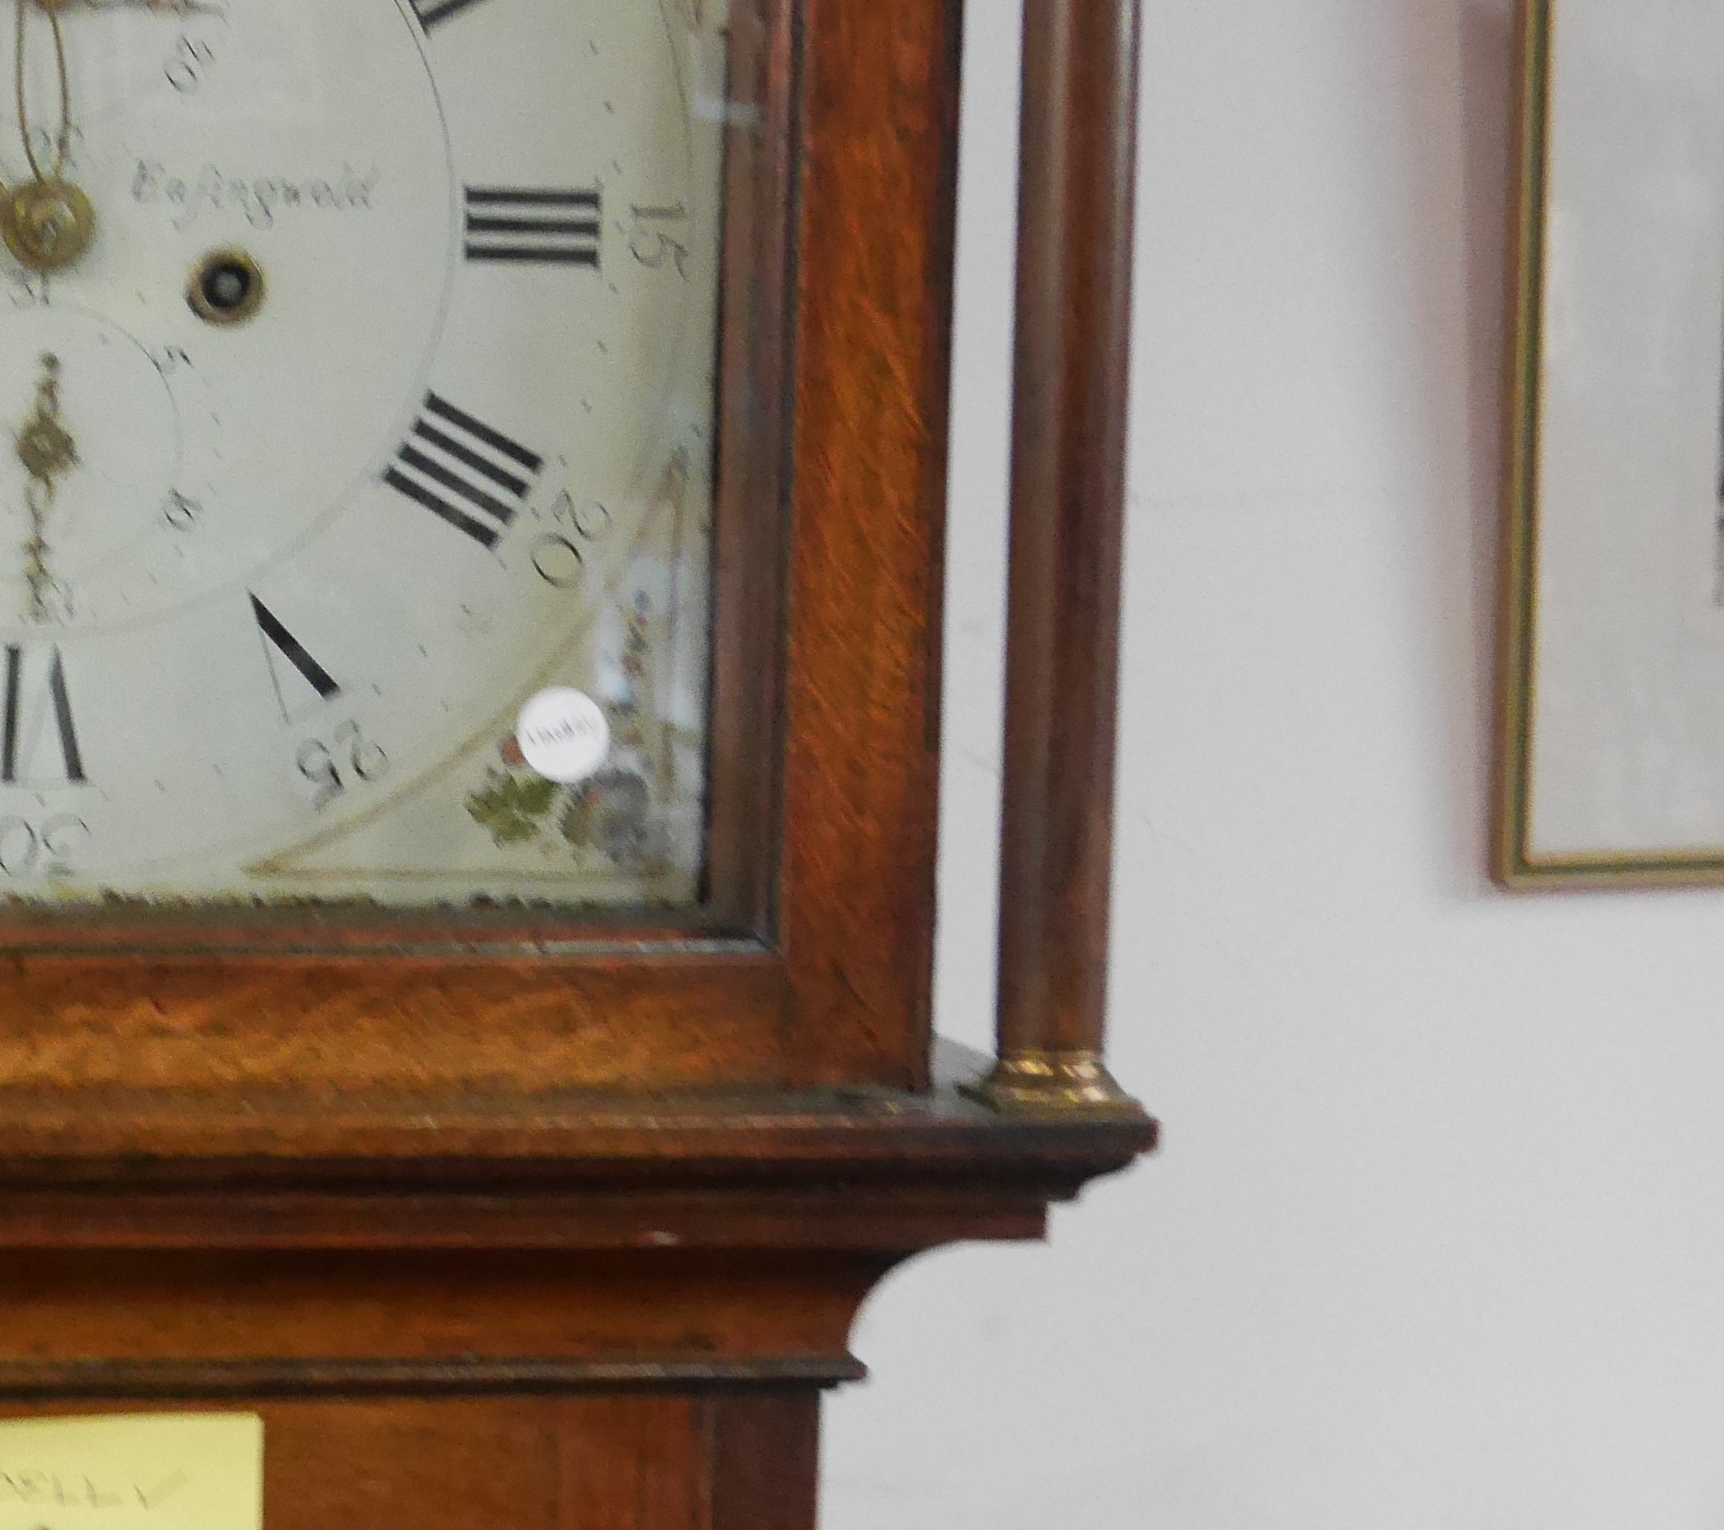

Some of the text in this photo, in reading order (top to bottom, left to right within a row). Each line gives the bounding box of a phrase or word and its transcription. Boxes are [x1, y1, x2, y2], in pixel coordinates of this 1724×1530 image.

[464, 185, 602, 268] III
[628, 199, 691, 282] 15
[381, 389, 544, 552] IIII
[530, 489, 611, 589] 20
